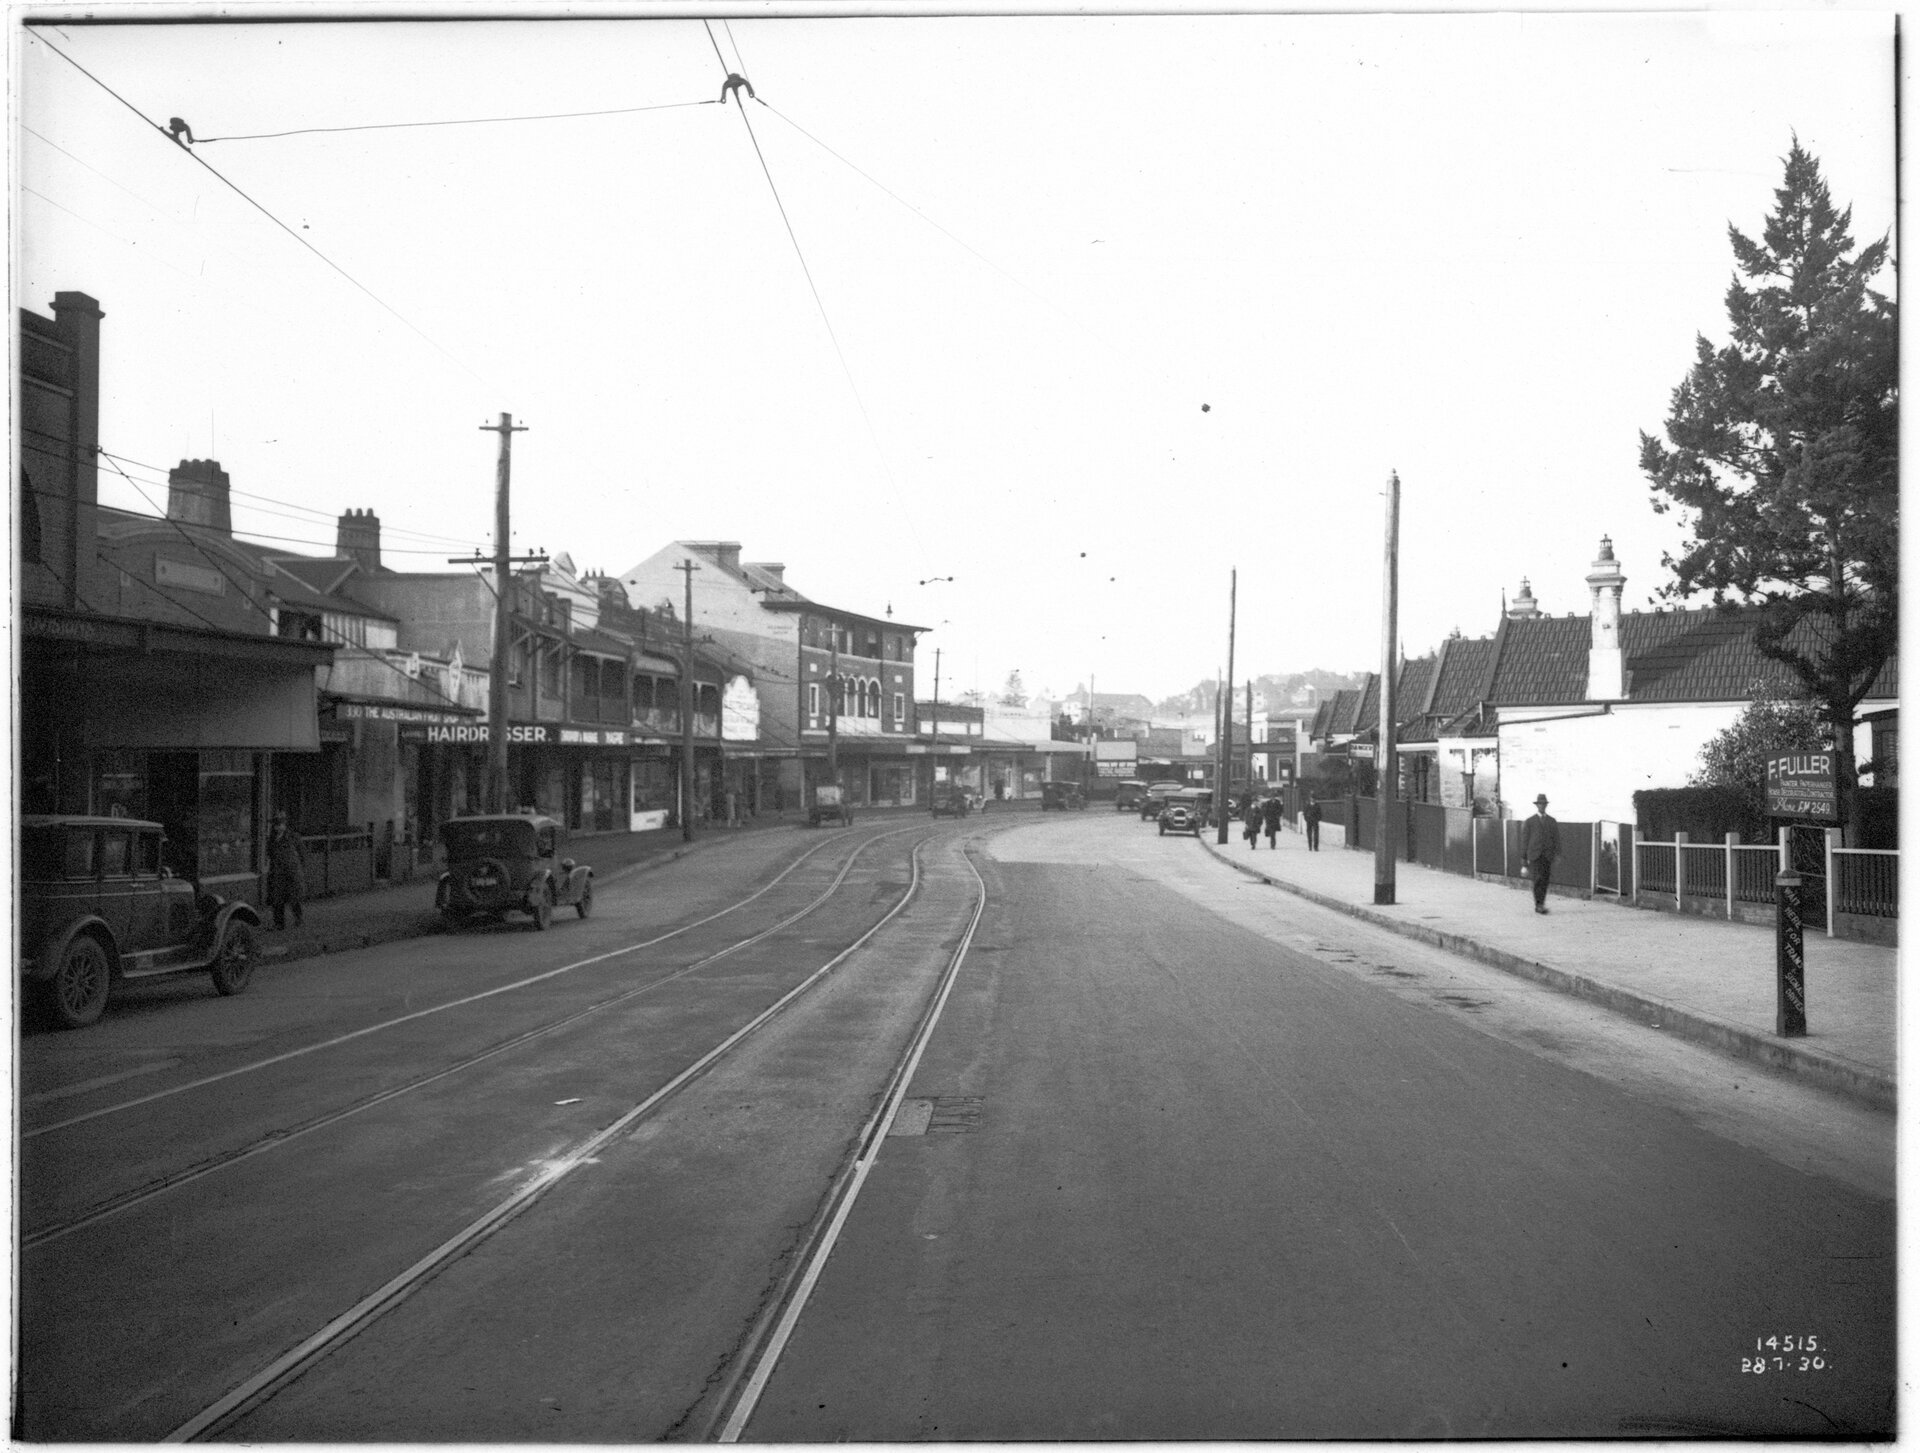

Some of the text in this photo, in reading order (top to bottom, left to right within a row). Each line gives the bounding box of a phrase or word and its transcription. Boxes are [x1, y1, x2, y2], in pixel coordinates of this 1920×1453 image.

[365, 705, 380, 719] THE
[1784, 887, 1801, 906] WAIT
[1784, 907, 1802, 930] HERE
[1786, 927, 1801, 946] FOR
[1785, 972, 1804, 998] SIGNAL
